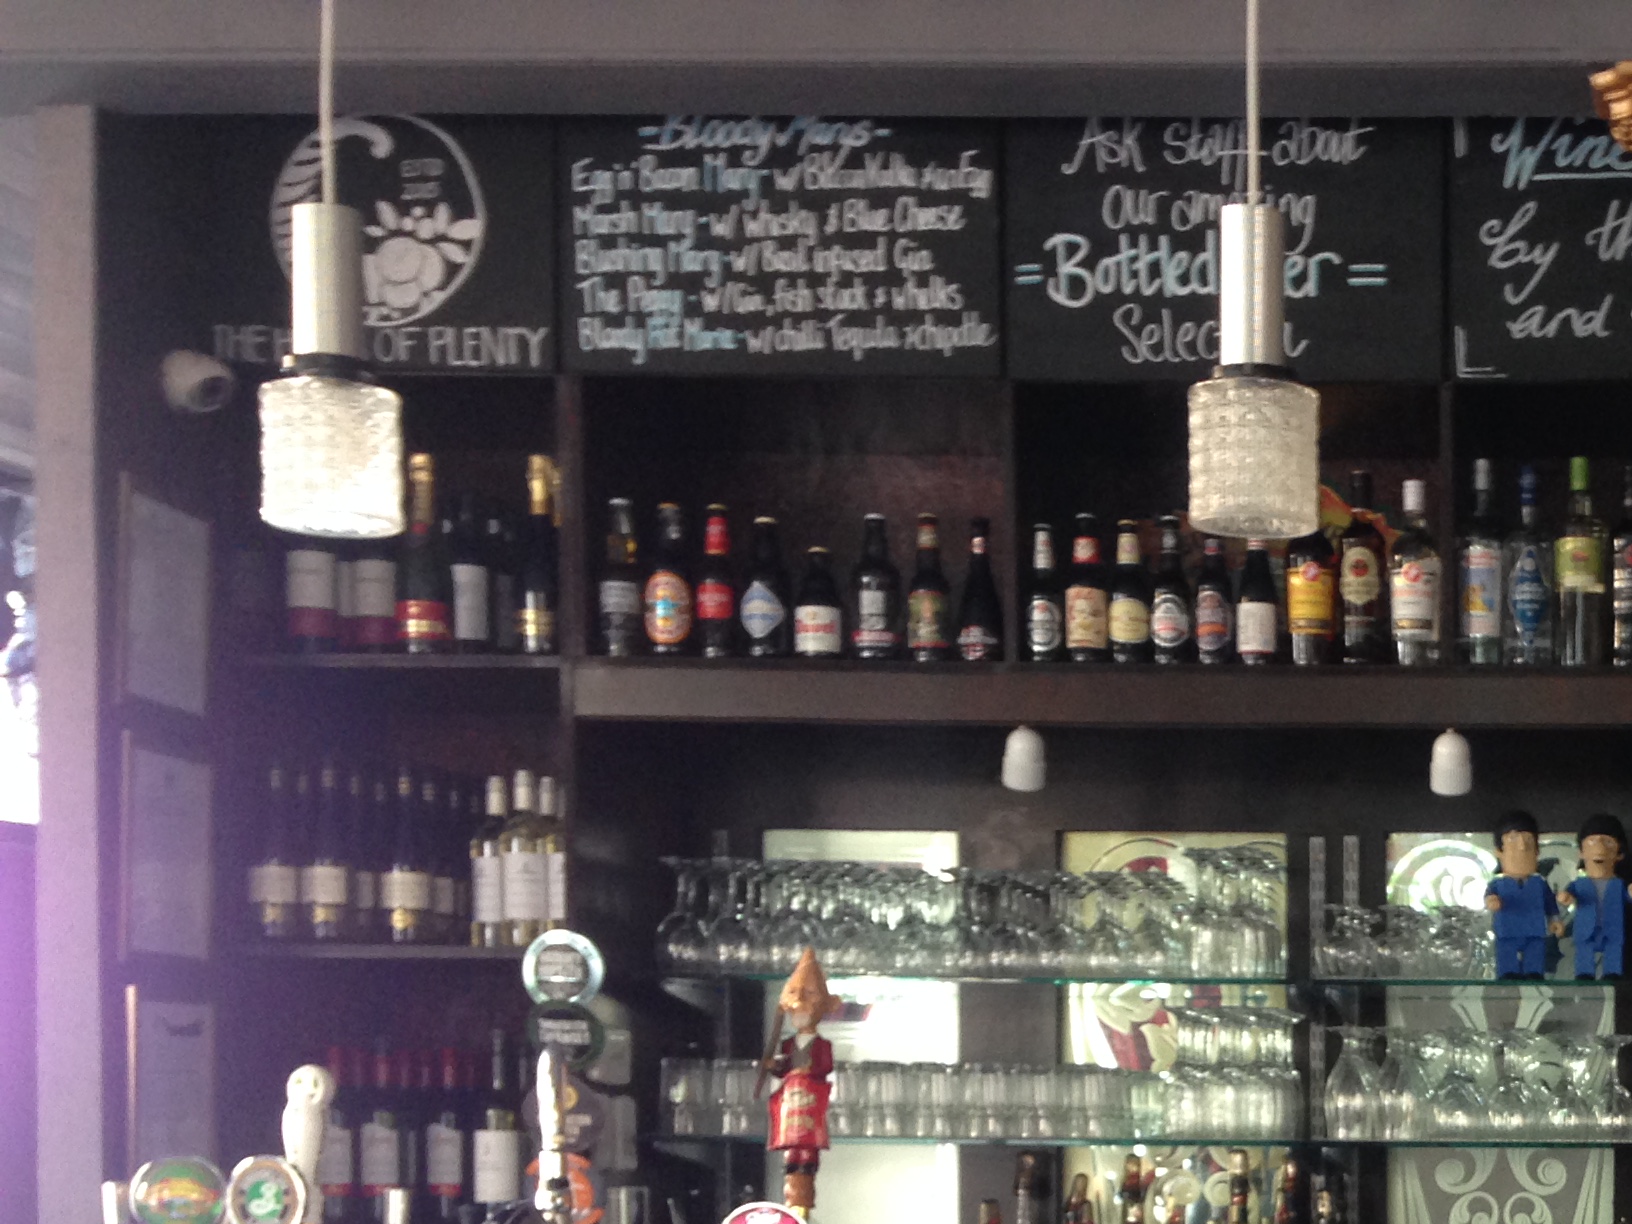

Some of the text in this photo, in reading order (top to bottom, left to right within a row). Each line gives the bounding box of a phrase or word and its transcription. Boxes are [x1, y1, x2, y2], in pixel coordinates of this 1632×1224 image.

[1061, 117, 1146, 175] Ask
[1479, 201, 1559, 305] by
[1507, 294, 1611, 340] and
[374, 326, 420, 363] OF
[427, 326, 548, 368] PLENTY
